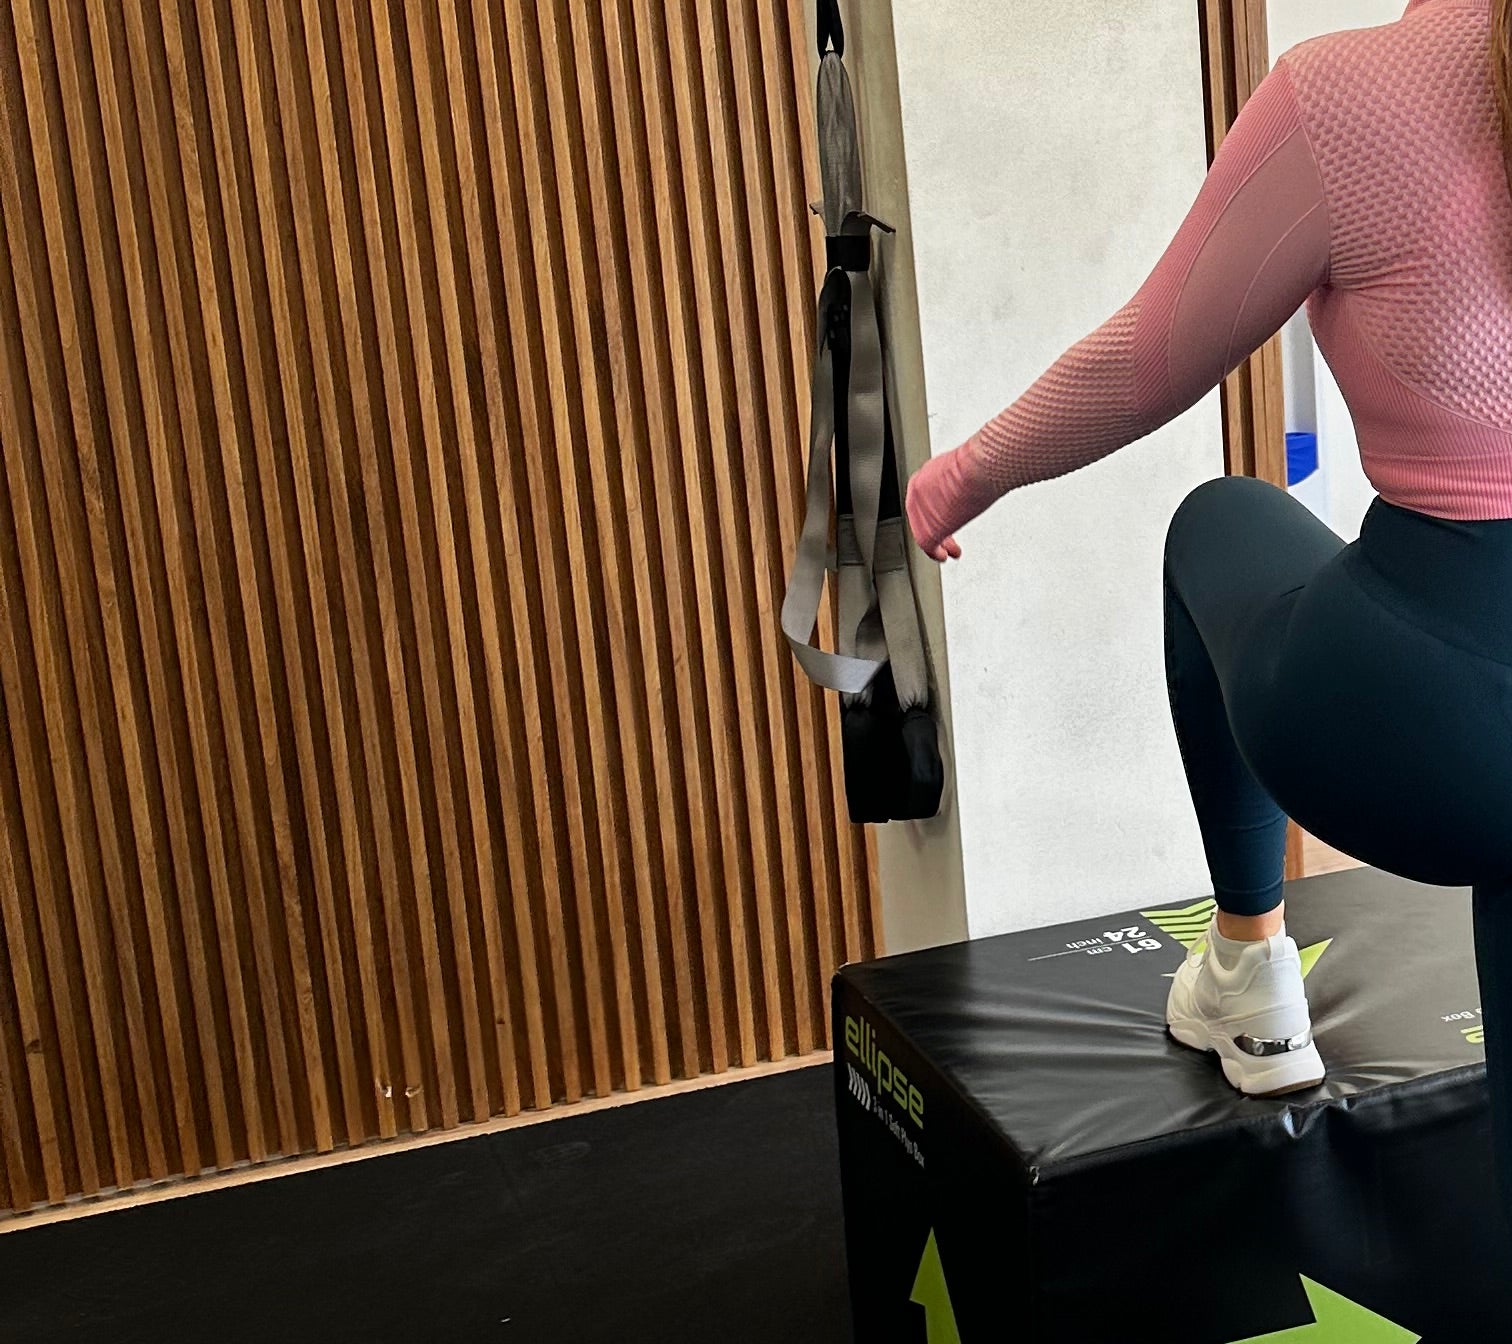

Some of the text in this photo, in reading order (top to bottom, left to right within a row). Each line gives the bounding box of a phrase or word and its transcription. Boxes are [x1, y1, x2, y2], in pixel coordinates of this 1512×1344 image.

[1066, 926, 1147, 949] 24 inch
[1086, 938, 1163, 955] 61 cm
[845, 1015, 924, 1130] ellipse
